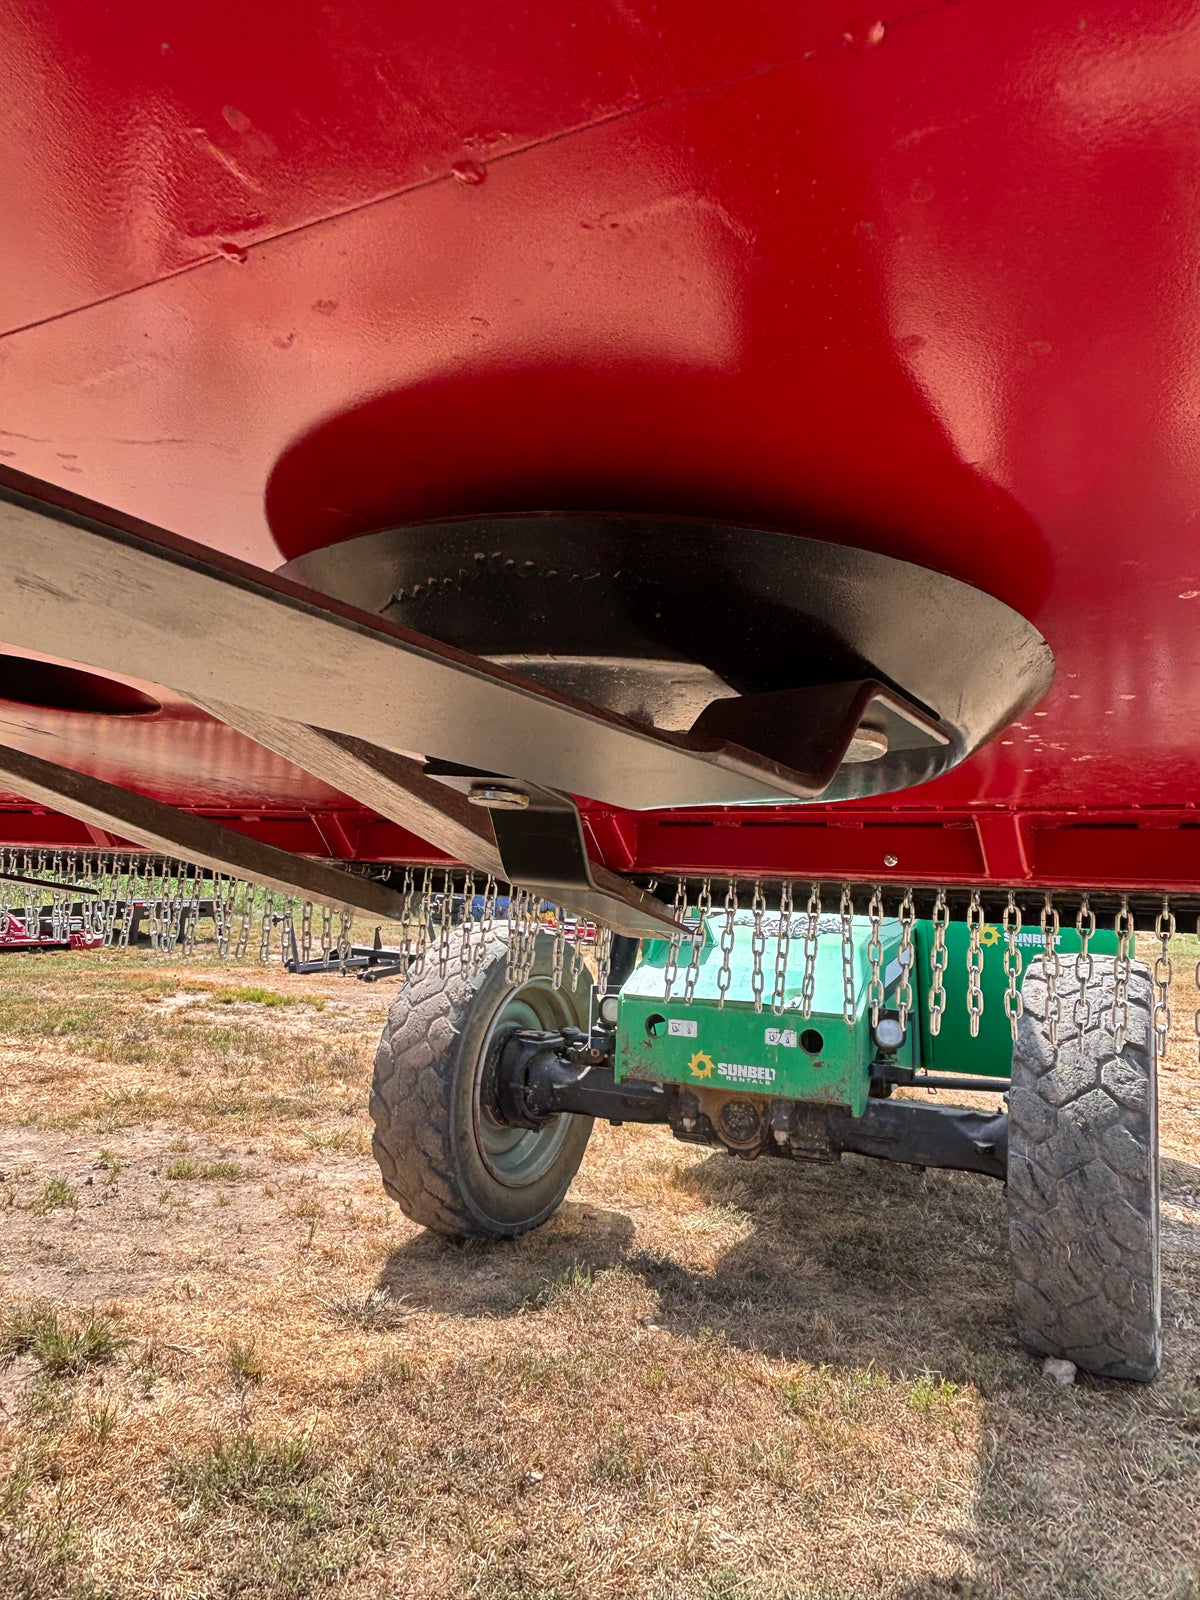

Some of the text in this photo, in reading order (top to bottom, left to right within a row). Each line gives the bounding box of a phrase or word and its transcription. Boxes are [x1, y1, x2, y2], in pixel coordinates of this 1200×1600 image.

[1003, 932, 1062, 945] SUNBET
[717, 1062, 776, 1081] SUNBELT
[726, 1075, 771, 1085] RENTALS
